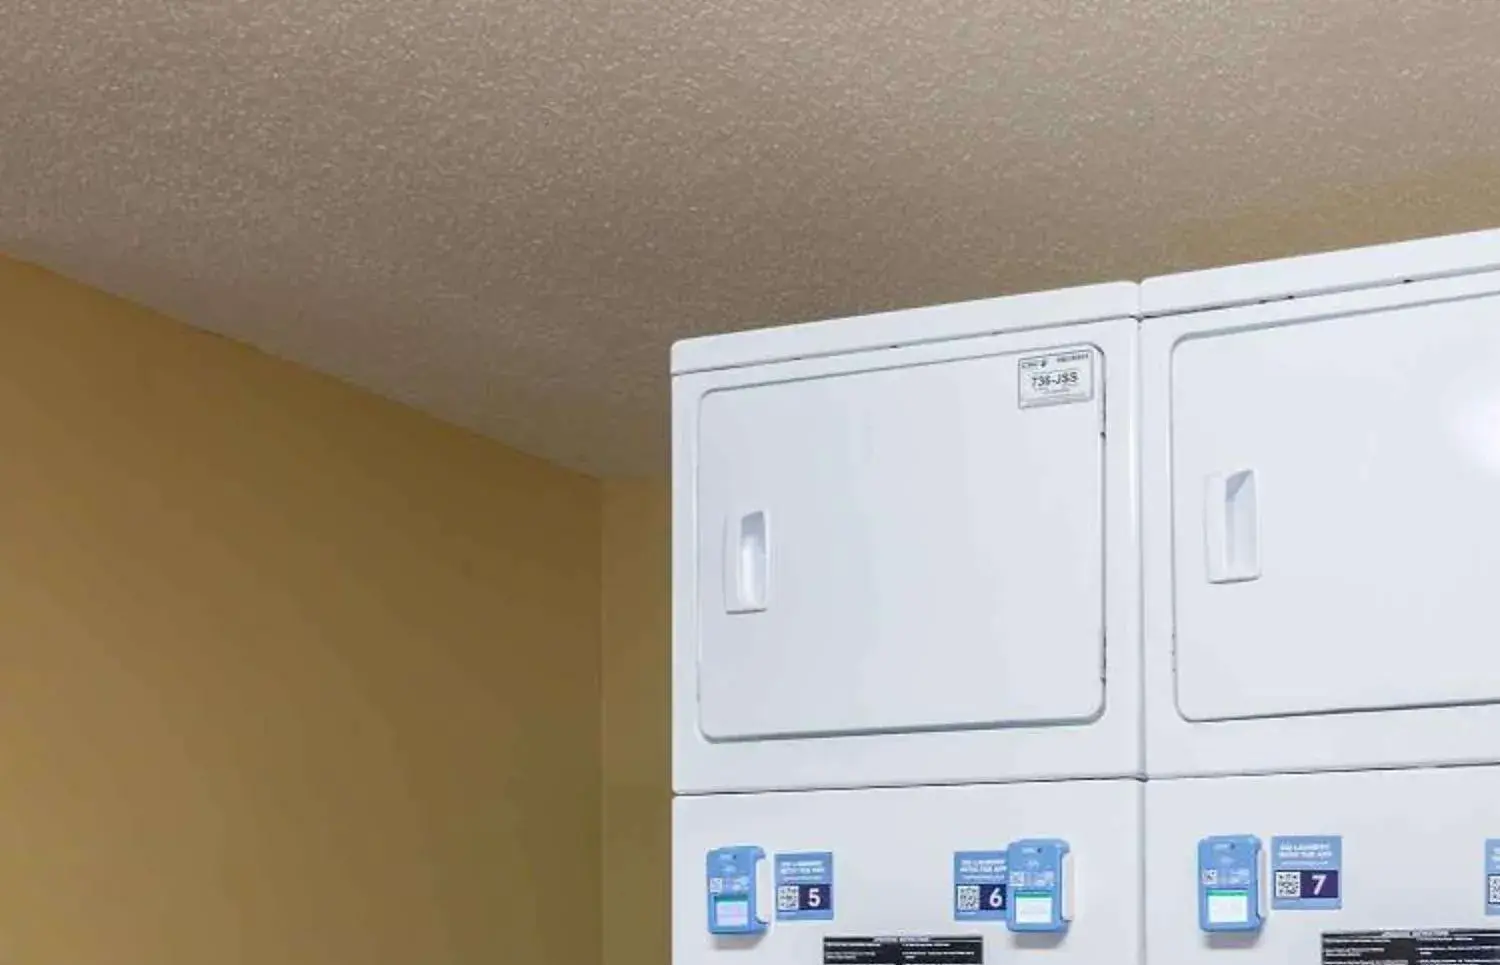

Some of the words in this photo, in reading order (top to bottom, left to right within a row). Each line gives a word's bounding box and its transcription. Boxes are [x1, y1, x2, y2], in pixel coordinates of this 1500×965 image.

[1311, 874, 1327, 896] 7
[808, 887, 821, 908] 5
[989, 887, 1003, 907] 6
